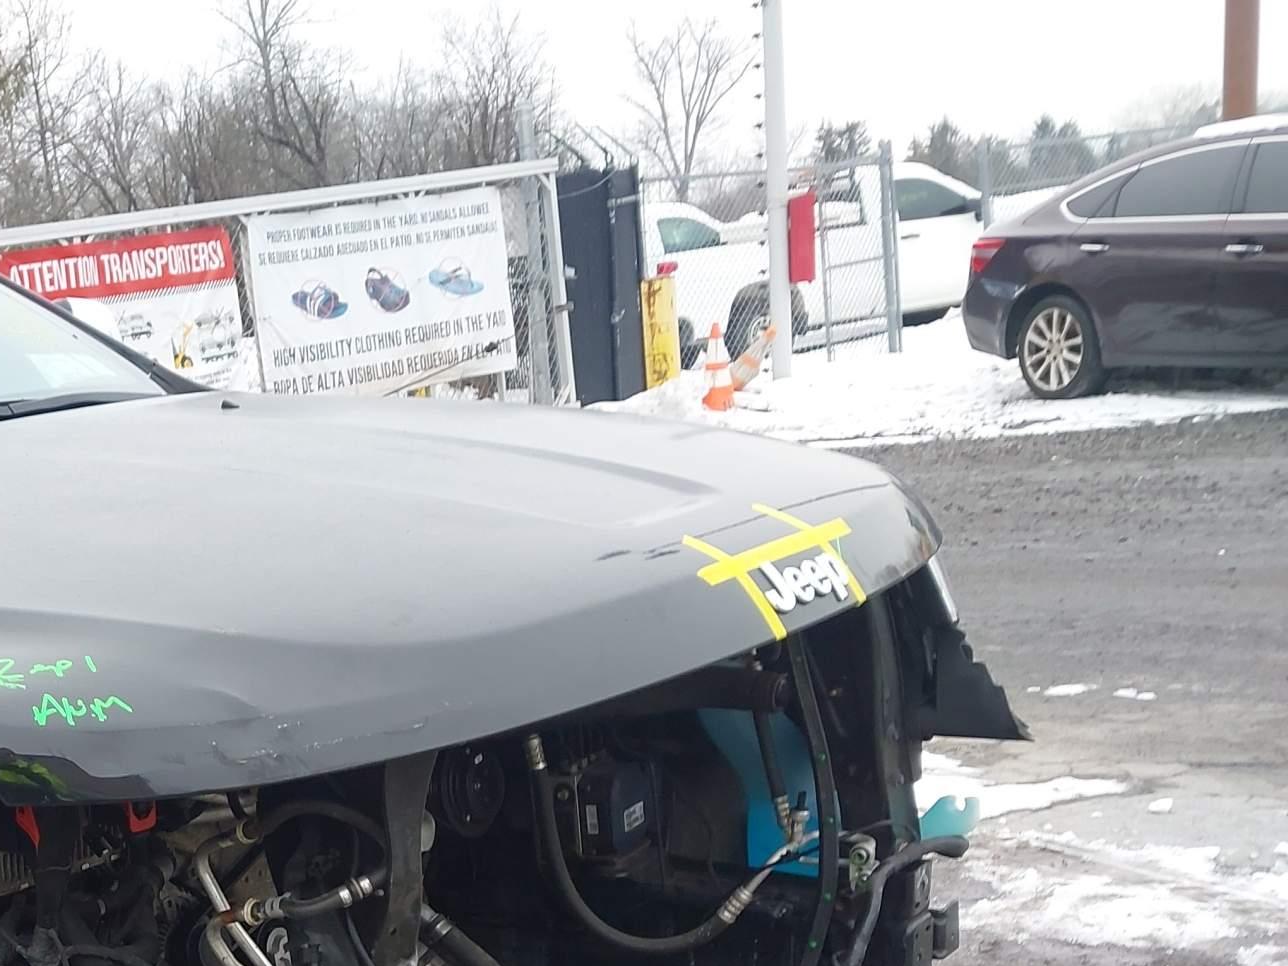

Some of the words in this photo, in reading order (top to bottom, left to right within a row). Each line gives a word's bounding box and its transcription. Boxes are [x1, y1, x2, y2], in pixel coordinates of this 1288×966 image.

[258, 251, 266, 267] SE
[267, 247, 299, 265] REQUIERE
[300, 244, 334, 261] CALZADO
[337, 240, 368, 257] ADECUADO
[369, 239, 379, 253] EN
[380, 238, 389, 251] EL
[415, 230, 424, 245] NO
[424, 229, 431, 244] SE
[432, 224, 466, 241] PERMITEN
[292, 224, 333, 241] FOOTWEAR
[335, 222, 342, 236] IS
[343, 219, 372, 234] REQUIRED
[373, 218, 381, 231] IN
[382, 215, 397, 229] THE
[420, 212, 427, 225] NO
[428, 208, 458, 224] SANDALS
[9, 255, 99, 294] ATTENTION
[101, 239, 226, 284] TRANSPORTERS!
[272, 347, 296, 368] HIGH
[299, 337, 352, 363] VISIBILITY
[354, 329, 402, 354] CLOTHING
[404, 319, 451, 345] REQUIRED
[453, 317, 464, 336] IN
[465, 313, 484, 333] THE
[273, 377, 299, 395] ROPA
[302, 375, 314, 394] DE
[317, 369, 345, 391] ALTA
[347, 359, 405, 385] VISIBILIDAD
[407, 347, 459, 374] REQUERIDA
[760, 552, 849, 613] Jeep
